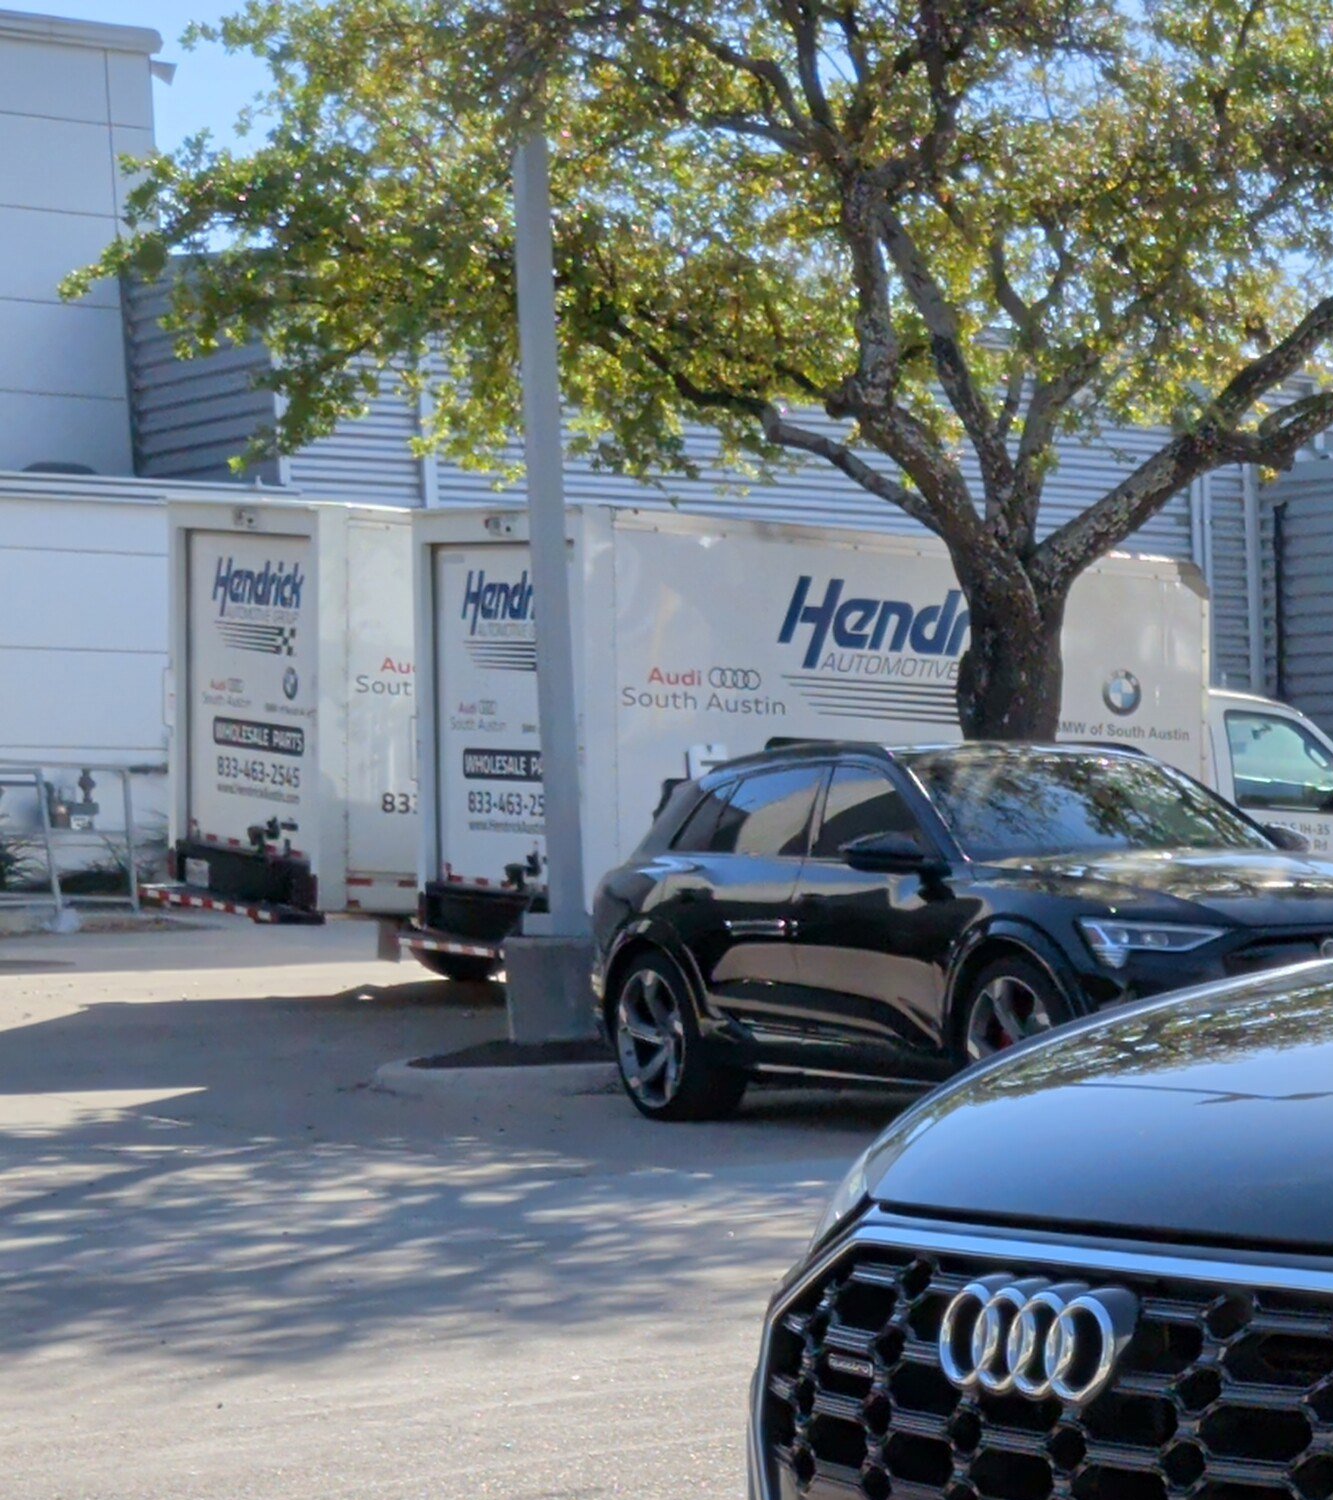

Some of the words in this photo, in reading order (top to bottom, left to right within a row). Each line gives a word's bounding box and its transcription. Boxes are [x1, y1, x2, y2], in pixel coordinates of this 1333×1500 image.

[212, 557, 304, 617] Hendrick
[461, 570, 535, 636] Hendr
[648, 667, 702, 686] Audi
[820, 652, 959, 680] AUTOMOTIVE
[356, 675, 411, 695] Sout
[622, 687, 697, 710] South
[706, 693, 786, 715] Austin
[214, 721, 270, 746] WHOLESALE
[272, 729, 303, 752] PARTS
[1090, 724, 1103, 736] of
[1107, 723, 1145, 739] South
[1148, 727, 1190, 742] Austin
[217, 756, 300, 788] 833-463-2545
[464, 754, 527, 776] WHOLESALE
